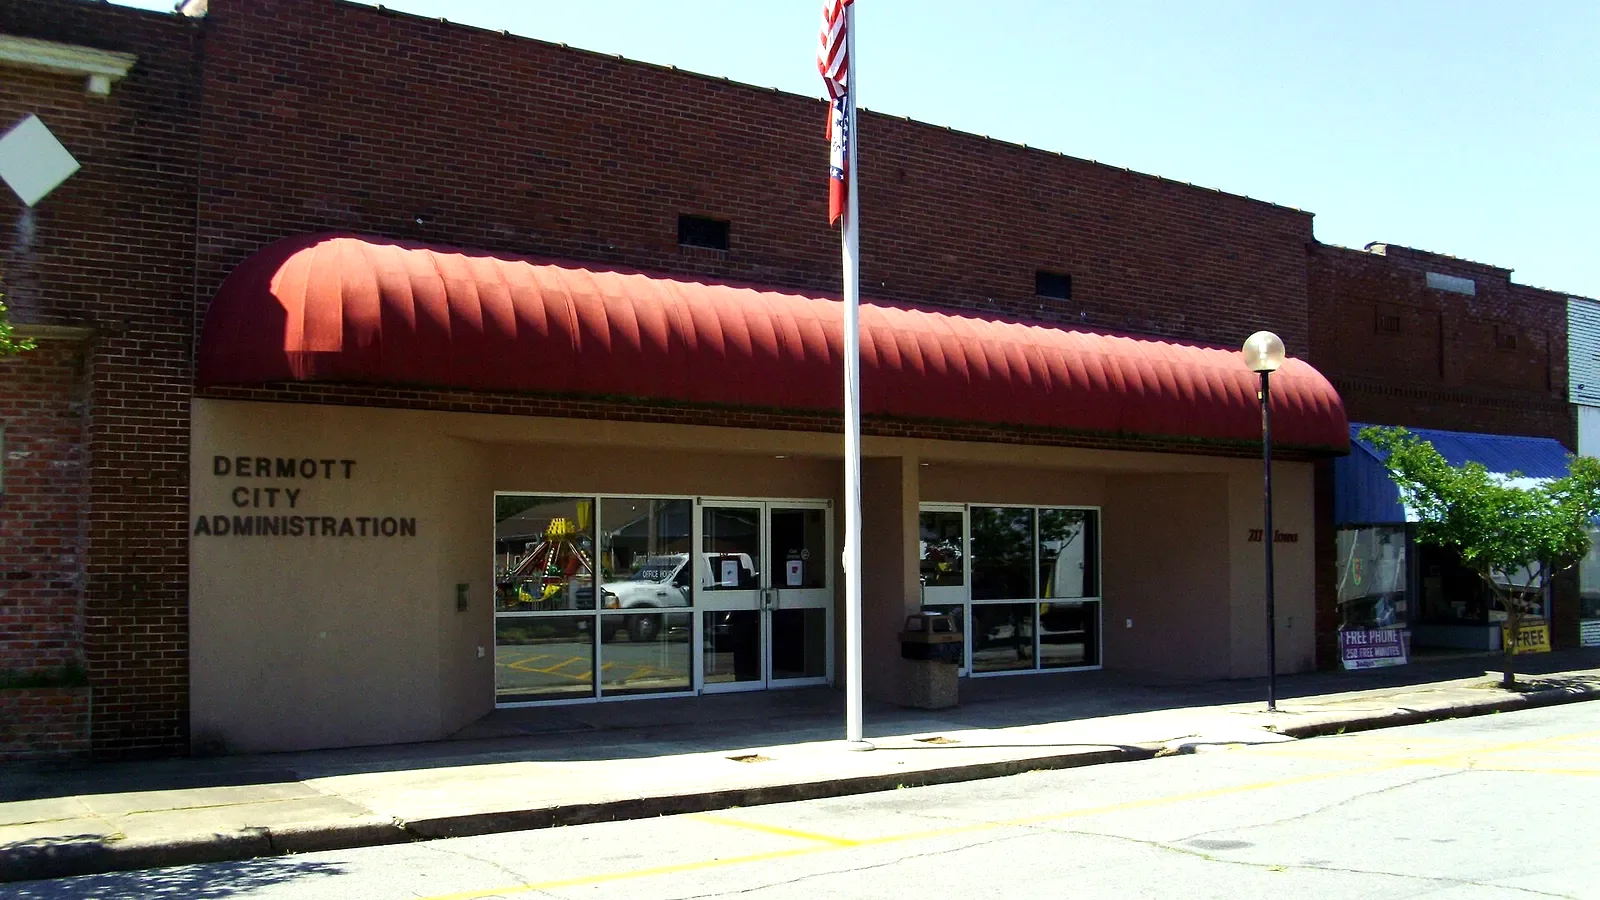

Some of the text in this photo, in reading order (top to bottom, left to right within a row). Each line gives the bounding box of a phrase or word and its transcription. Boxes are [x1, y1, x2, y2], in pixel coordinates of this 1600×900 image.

[213, 455, 357, 479] DERMOTT
[231, 486, 302, 508] CITY
[194, 514, 417, 537] ADMINISTRATION
[642, 569, 659, 578] OFFICE
[1346, 629, 1398, 645] FREE PHONE
[1516, 629, 1546, 648] FREE
[1346, 646, 1401, 659] 250 FREE MINUTES
